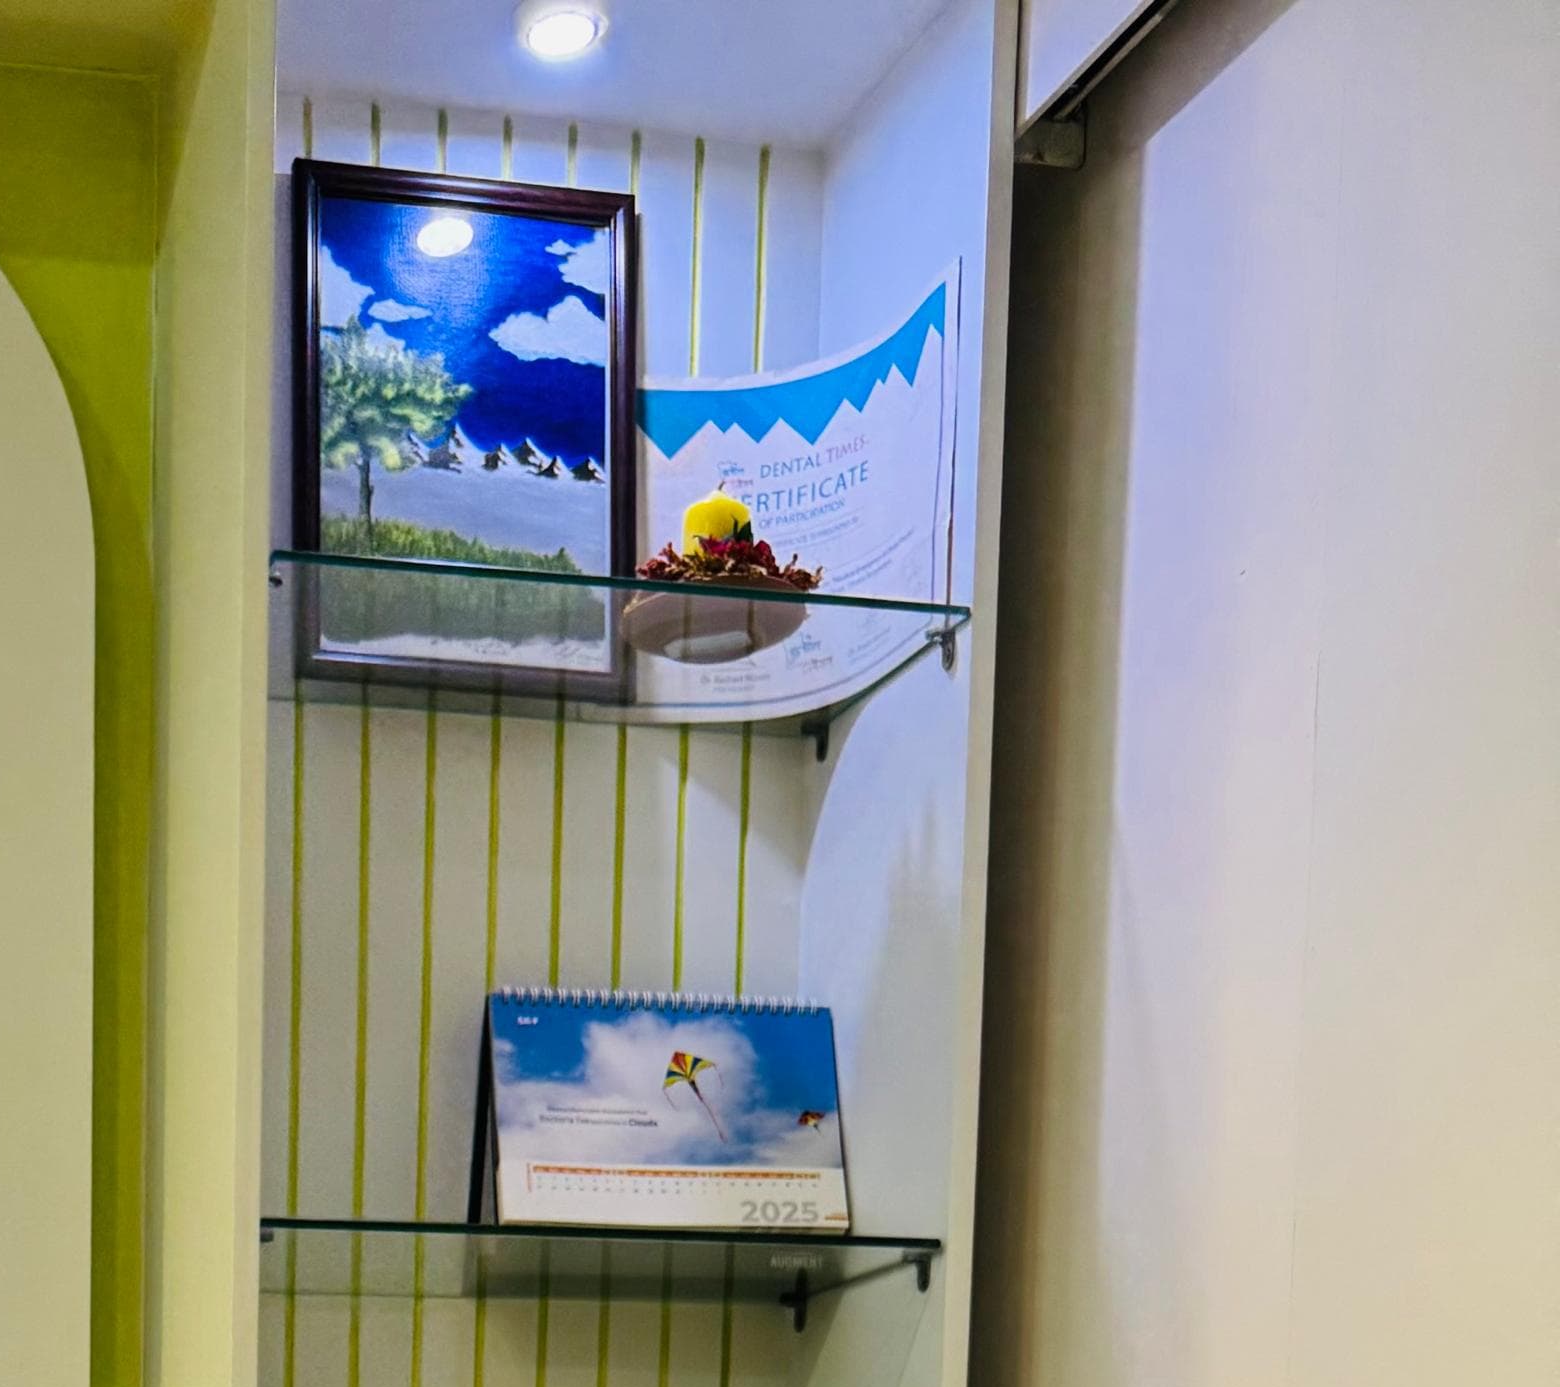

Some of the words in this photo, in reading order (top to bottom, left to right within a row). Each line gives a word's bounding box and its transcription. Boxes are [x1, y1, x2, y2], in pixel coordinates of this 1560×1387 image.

[760, 451, 822, 479] DENTAL
[740, 459, 869, 513] ERTIFICATE
[741, 1200, 819, 1223] 2025
